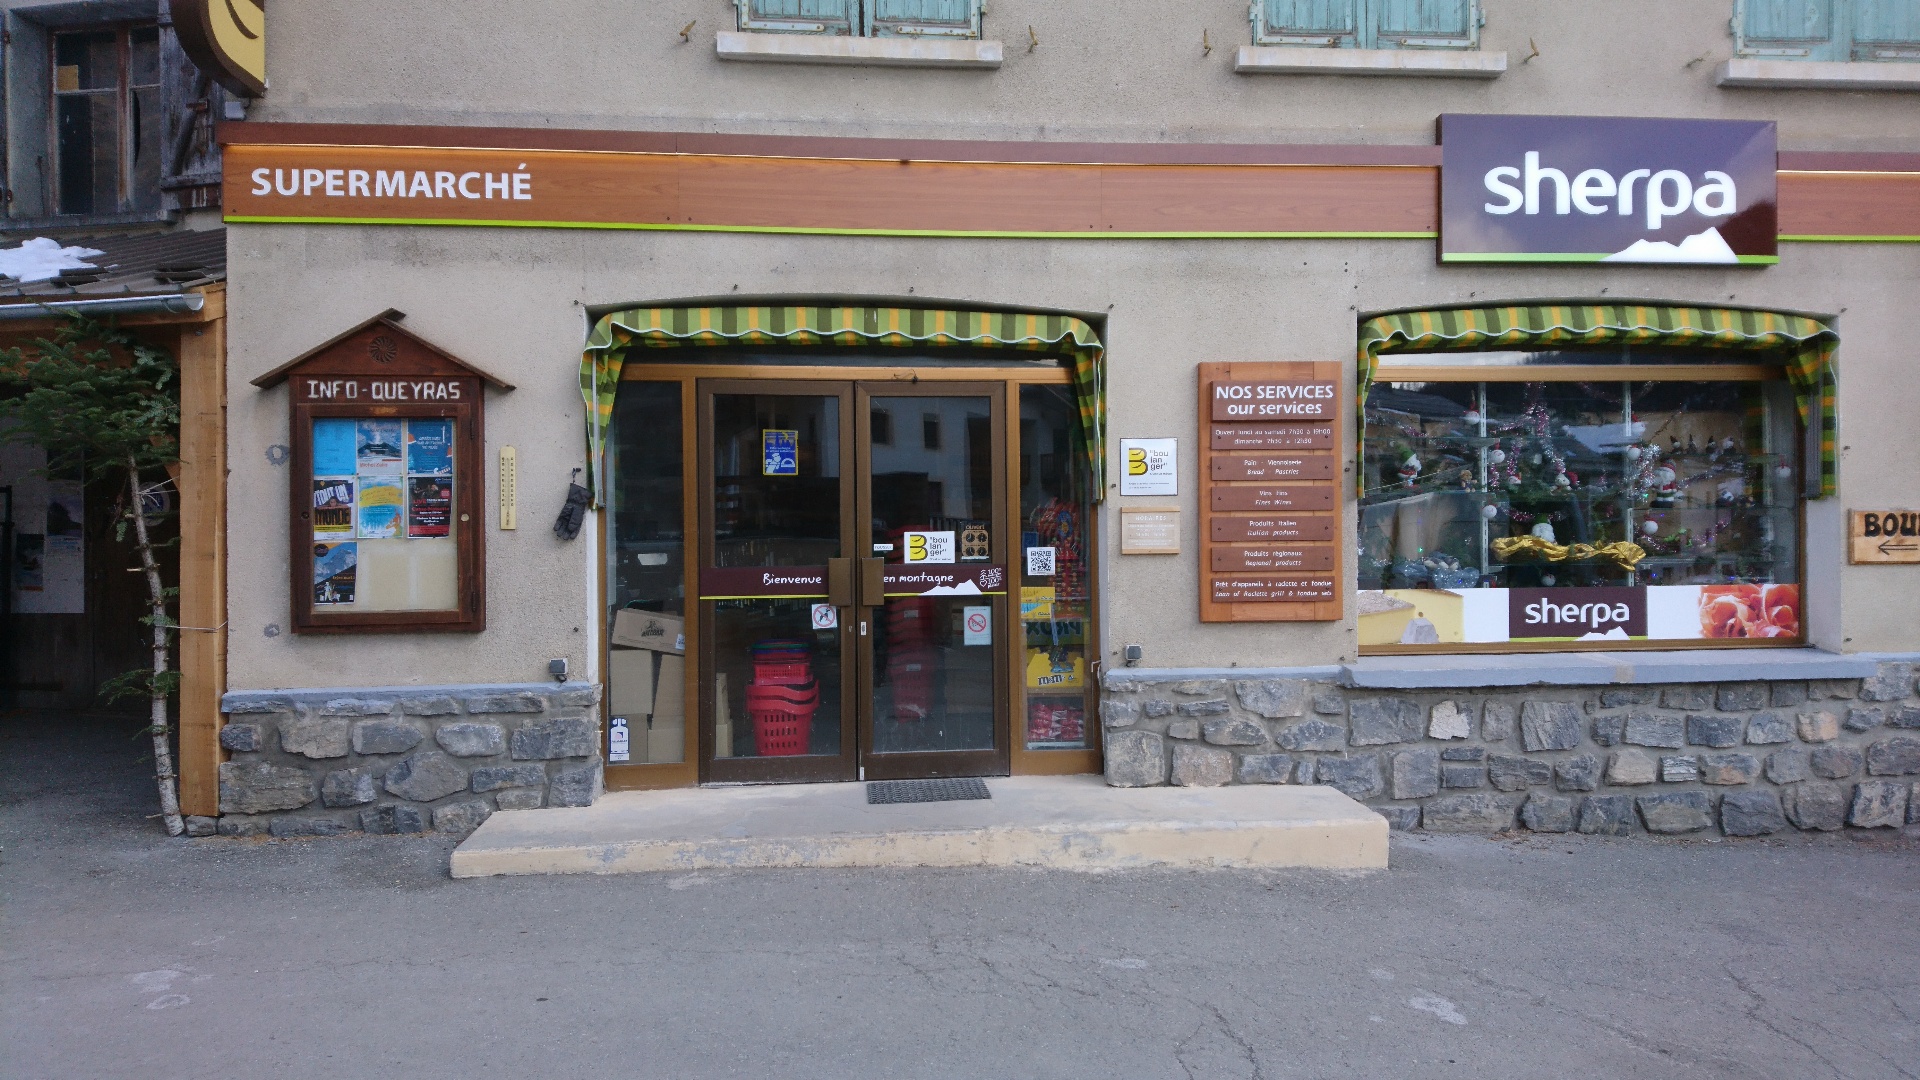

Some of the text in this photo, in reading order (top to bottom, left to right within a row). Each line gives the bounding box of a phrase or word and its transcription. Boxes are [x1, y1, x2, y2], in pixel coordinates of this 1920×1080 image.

[251, 162, 532, 200] SUPERMARCHÉ
[1483, 151, 1737, 230] sherpa
[307, 380, 358, 399] INFO
[371, 382, 460, 401] QUEYRAS
[1216, 385, 1334, 399] NOS SERVICES
[1227, 401, 1323, 415] our services
[1864, 512, 1920, 538] BOU
[1245, 559, 1302, 567] Regional products
[763, 572, 822, 586] Bienvenue
[883, 571, 954, 586] en montagne
[1525, 597, 1630, 628] sherpa
